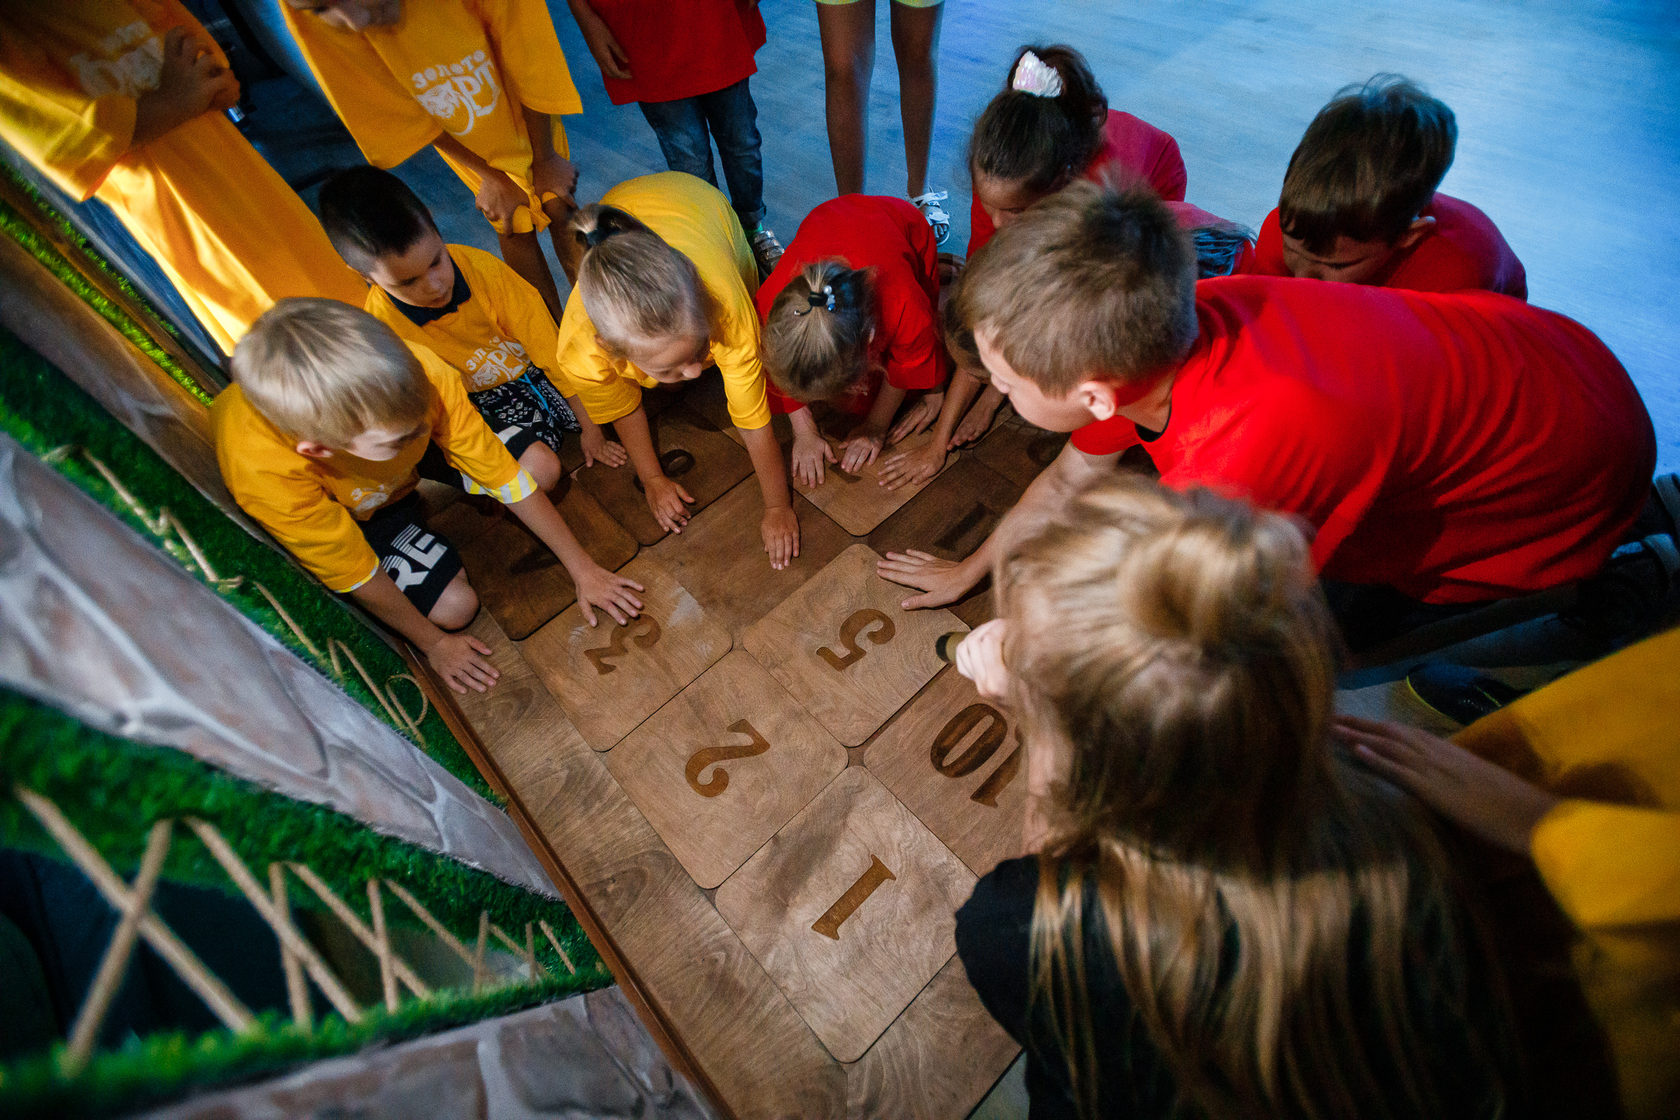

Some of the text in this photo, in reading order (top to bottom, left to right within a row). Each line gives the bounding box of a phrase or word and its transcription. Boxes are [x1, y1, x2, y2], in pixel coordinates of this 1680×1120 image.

[584, 612, 662, 676] 3
[816, 607, 897, 672] 5
[684, 718, 771, 798] 2
[930, 703, 1024, 808] 10
[811, 854, 897, 941] 1
